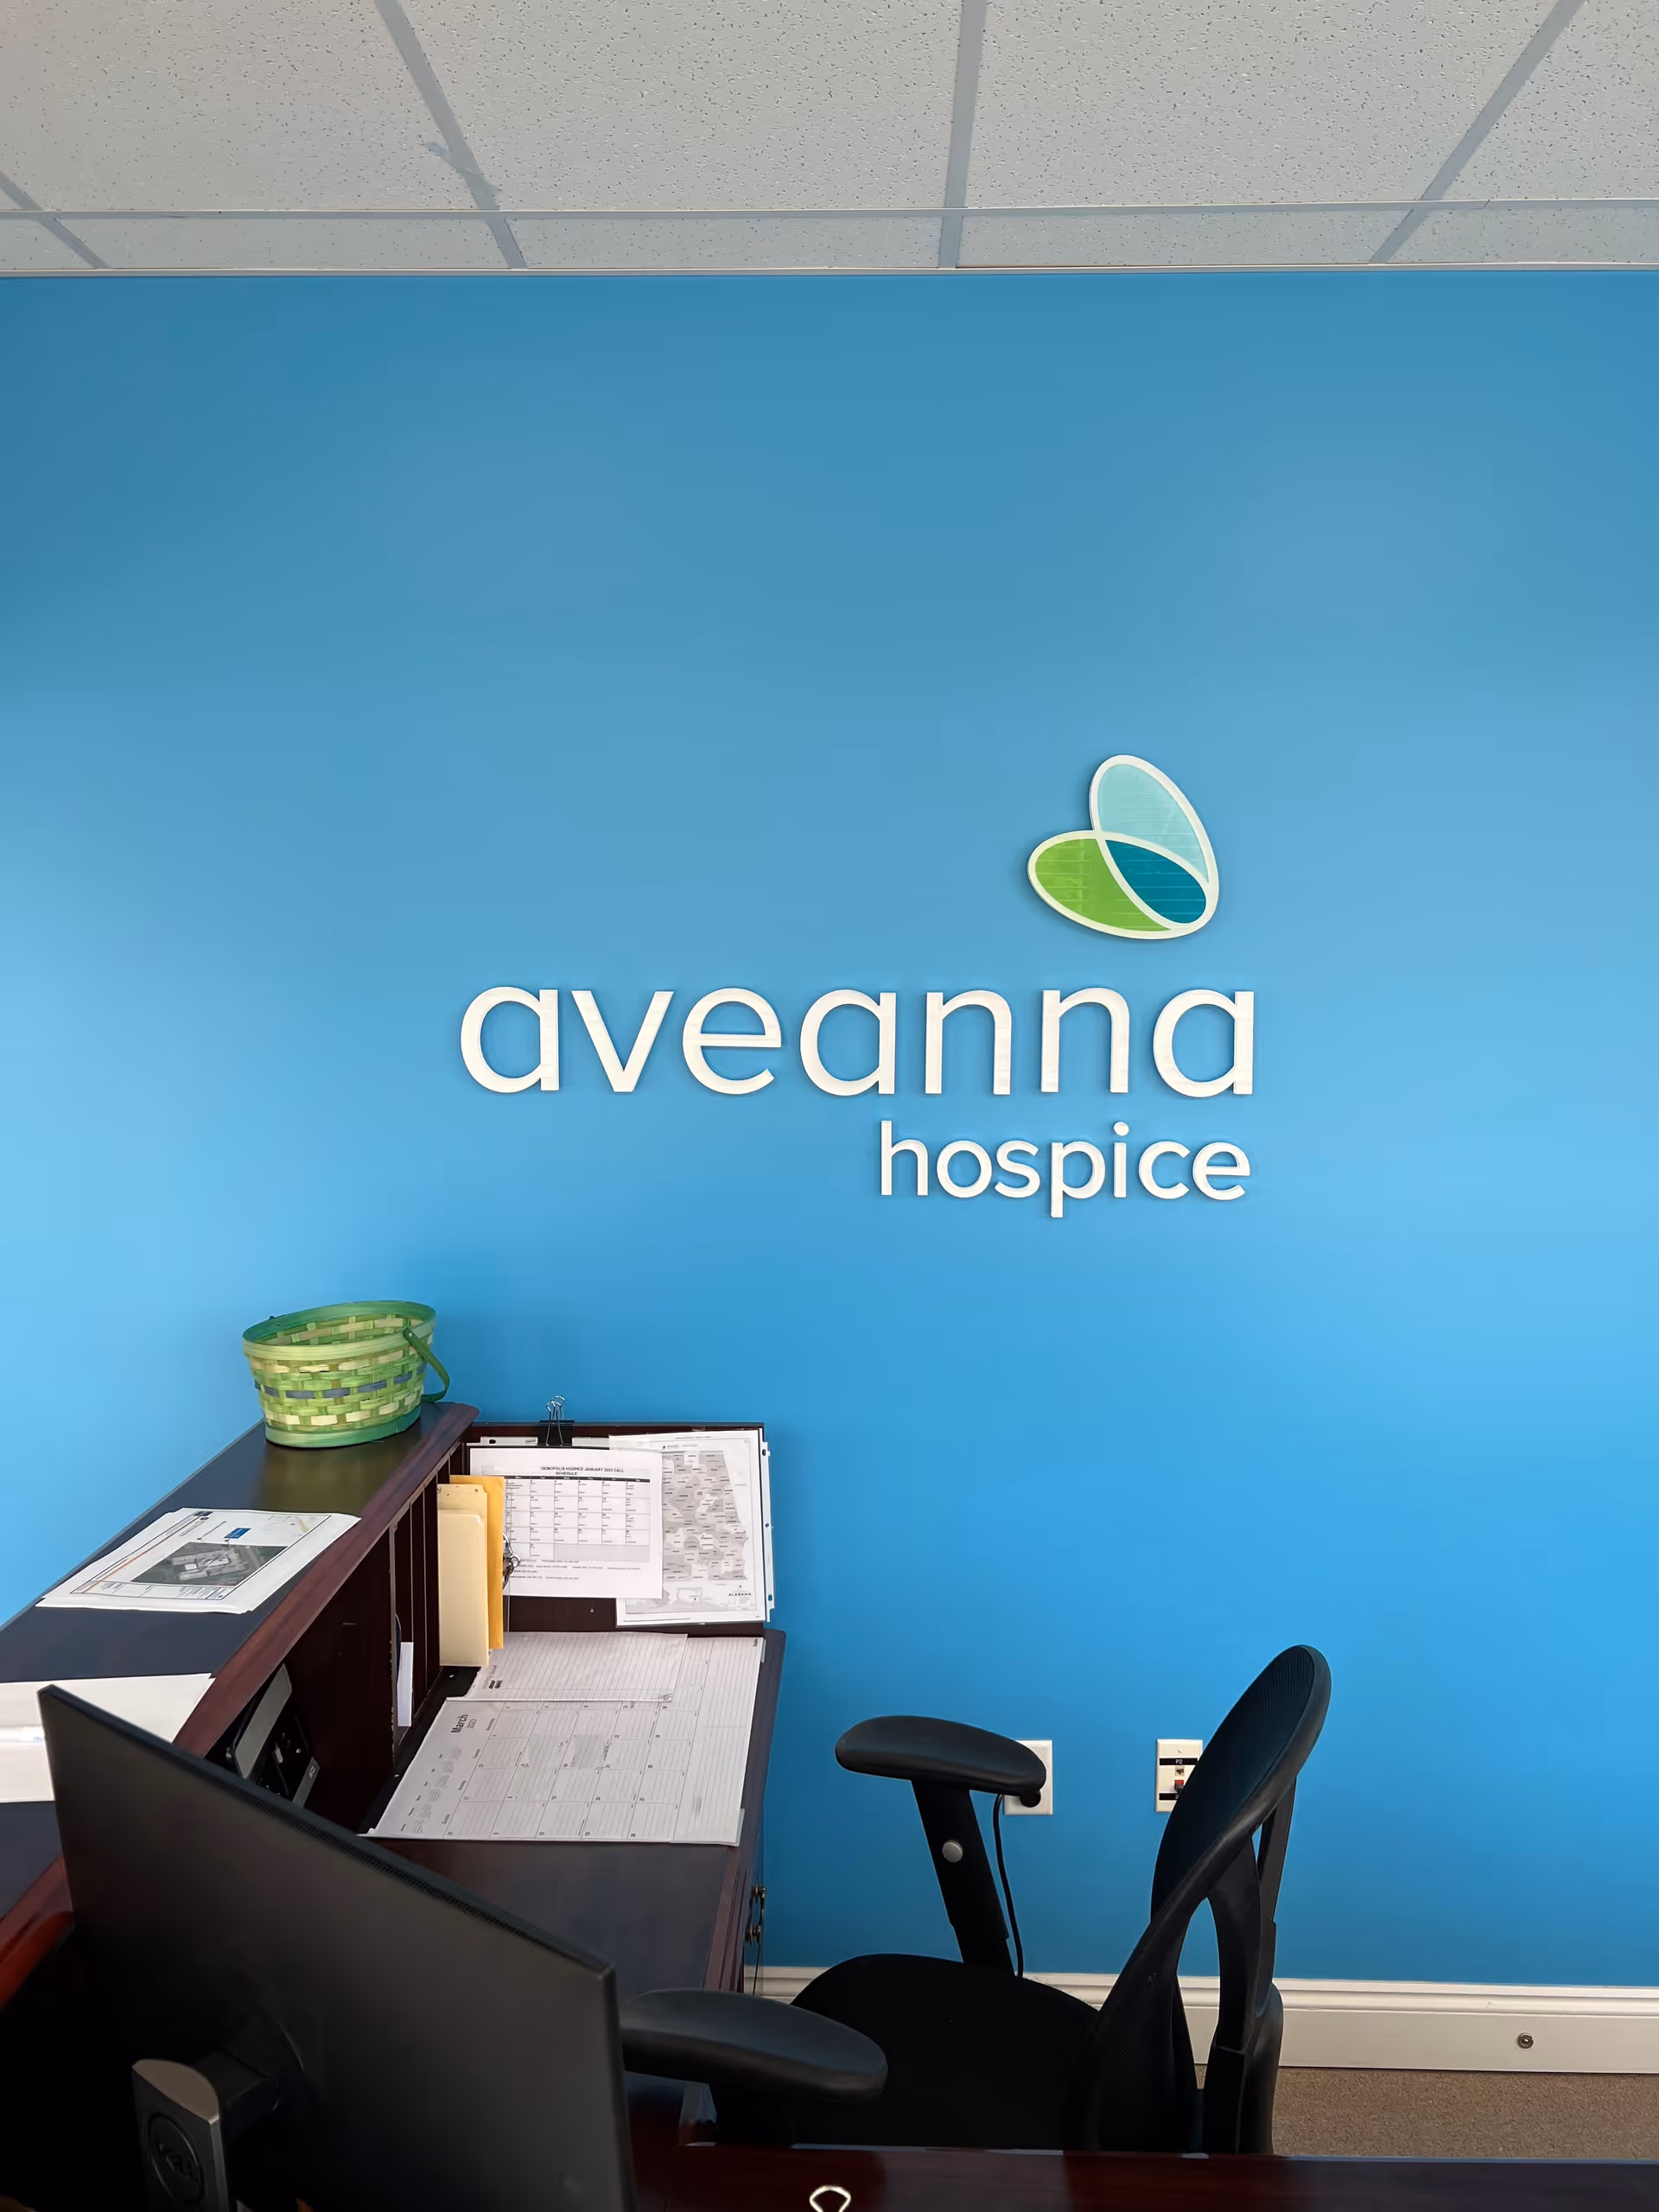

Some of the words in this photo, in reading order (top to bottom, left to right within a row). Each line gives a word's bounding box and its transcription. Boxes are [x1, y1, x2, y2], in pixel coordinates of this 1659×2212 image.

[461, 986, 1255, 1098] aveanna
[880, 1121, 1251, 1219] hospice
[450, 1714, 469, 1733] March
